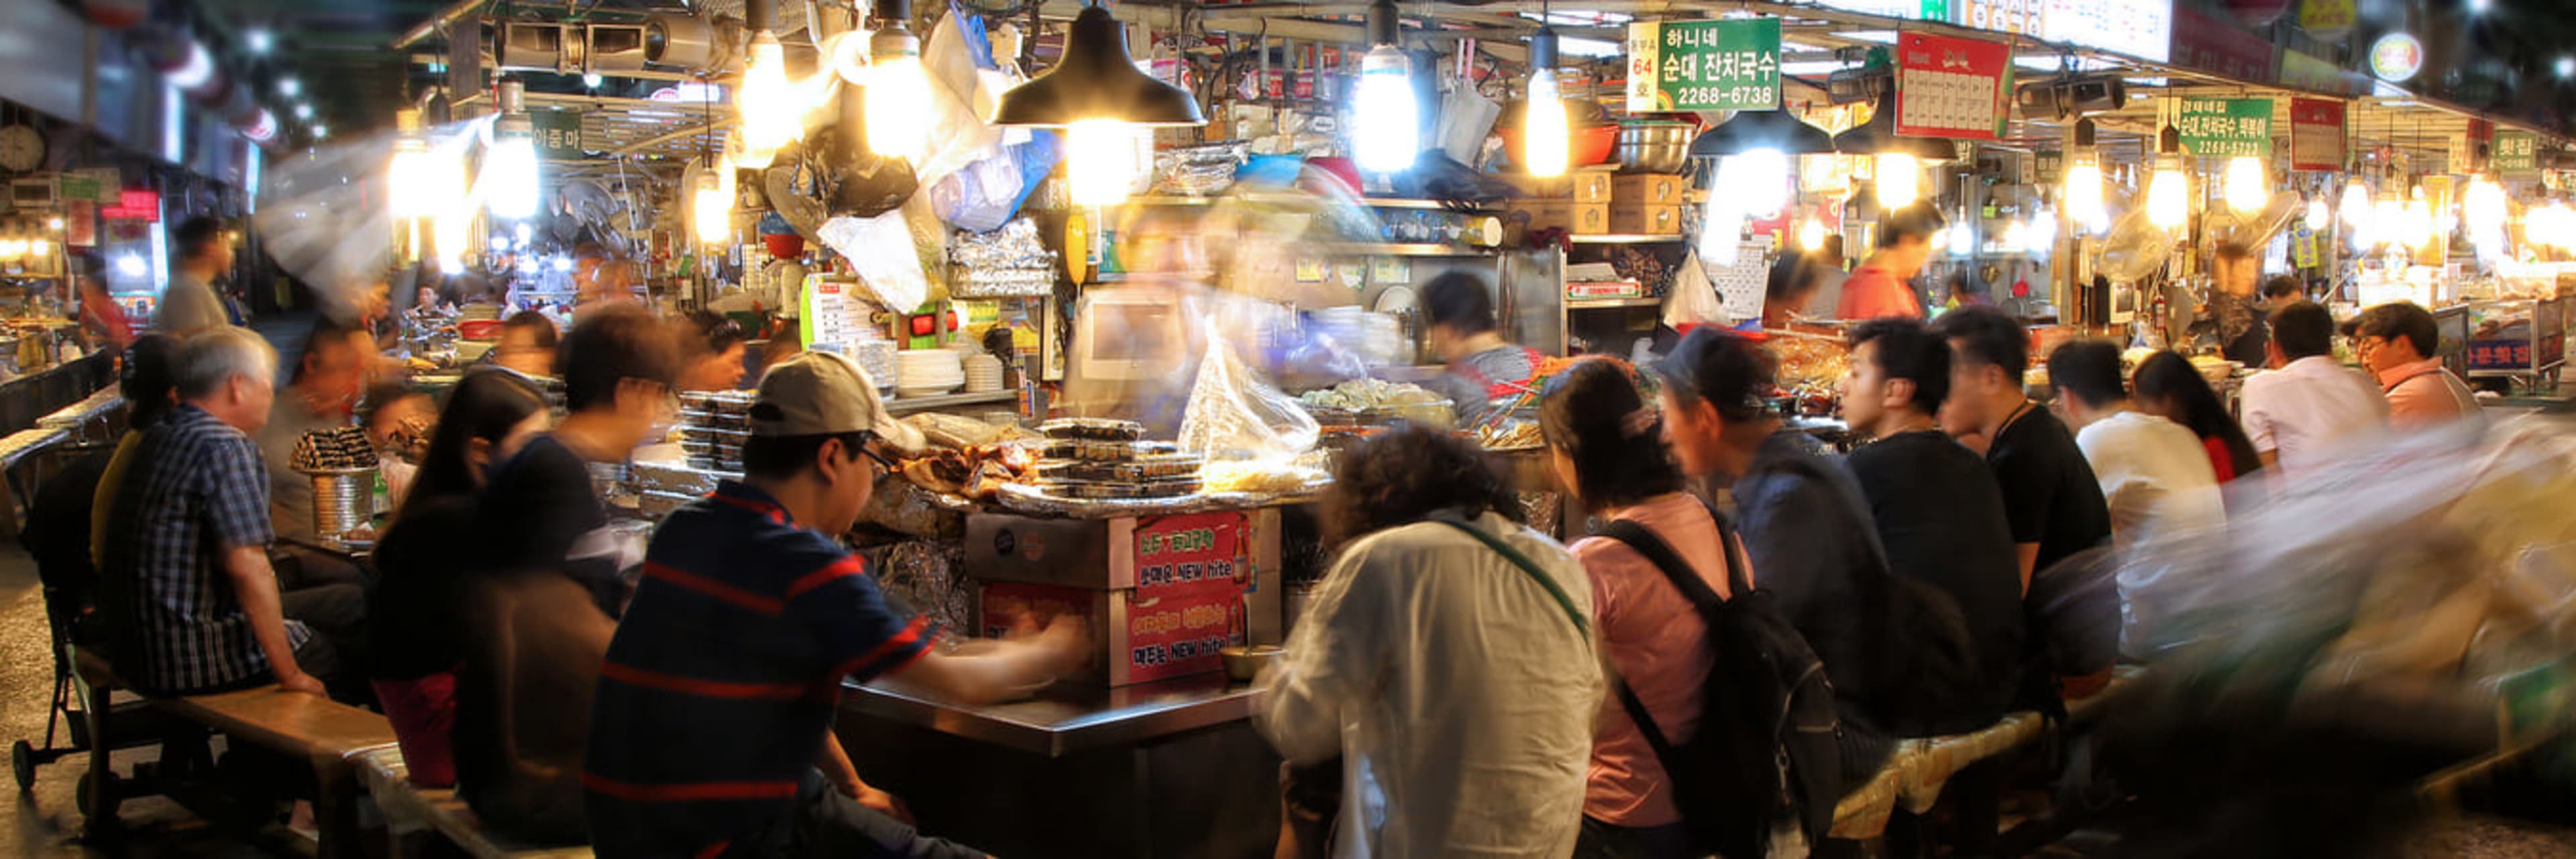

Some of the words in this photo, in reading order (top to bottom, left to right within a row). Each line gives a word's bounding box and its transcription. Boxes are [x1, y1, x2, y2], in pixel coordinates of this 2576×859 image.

[1666, 28, 1718, 48] 하니네
[1633, 58, 1652, 75] 64
[1663, 52, 1698, 82] 순대
[1705, 51, 1776, 83] 잔치국수
[1678, 87, 1772, 104] 2268-6738
[1177, 562, 1203, 580] NEW
[1207, 559, 1232, 578] hite
[1171, 640, 1197, 660] NEW
